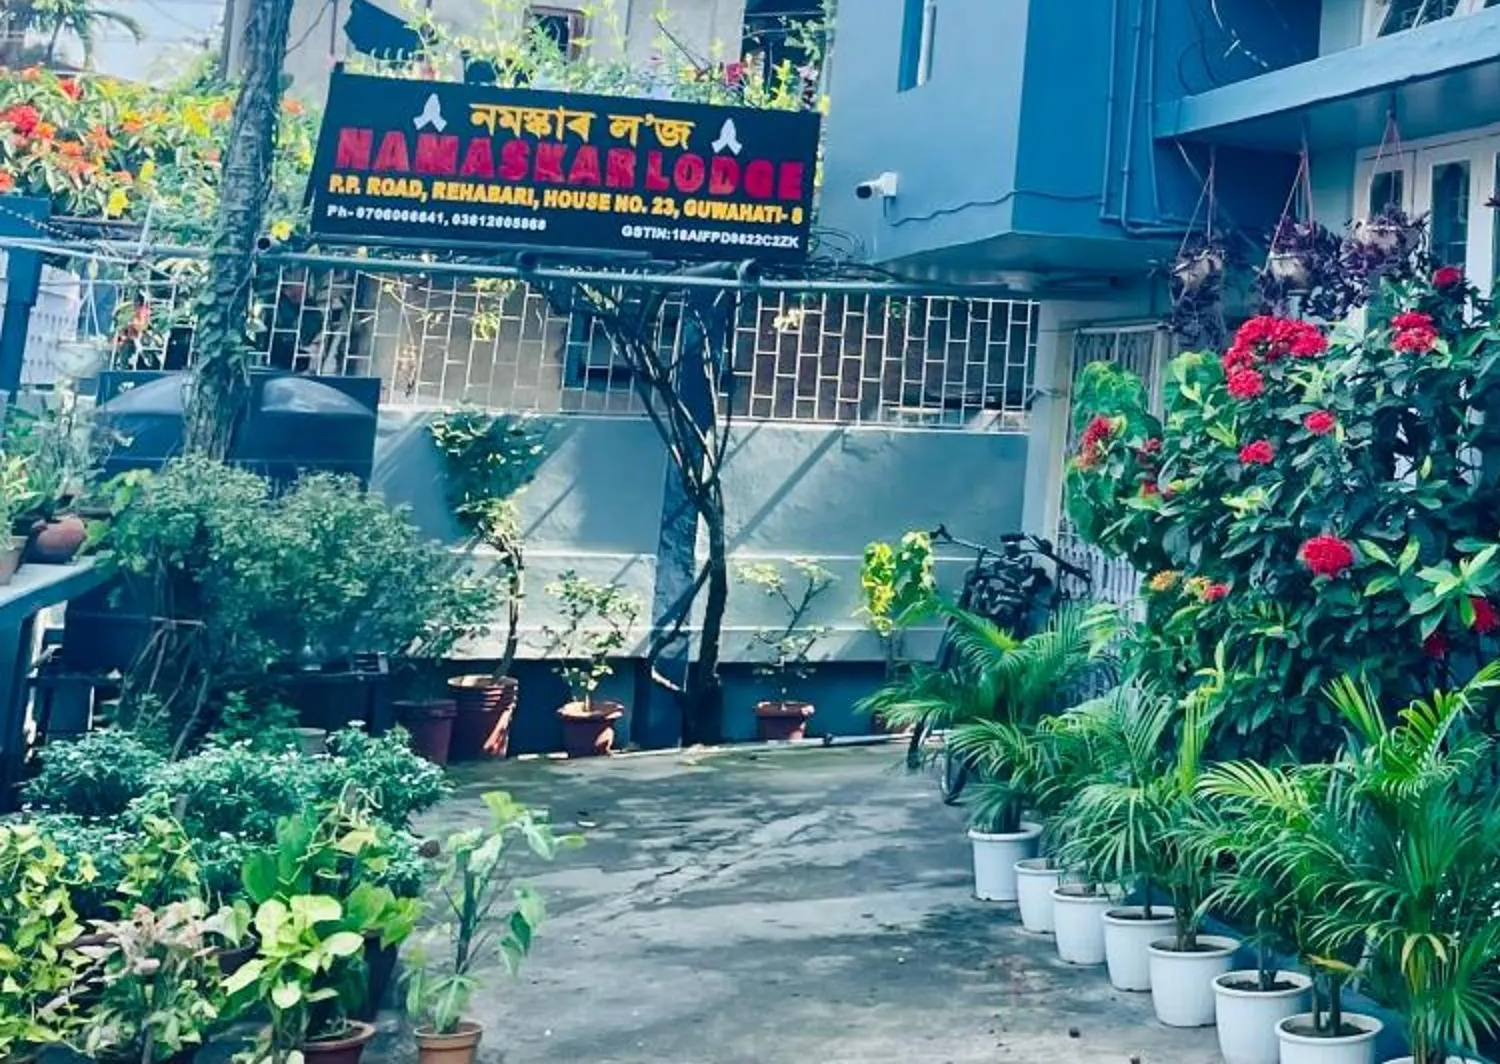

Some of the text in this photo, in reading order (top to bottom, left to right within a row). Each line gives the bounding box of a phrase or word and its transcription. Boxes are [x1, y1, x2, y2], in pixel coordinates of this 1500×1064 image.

[336, 128, 805, 200] NAMASKAR LODGE
[367, 176, 427, 201] ROAD,
[432, 181, 540, 209] REHABARI,
[543, 190, 611, 211] HOUSE
[614, 194, 647, 214] NO.
[651, 197, 679, 218] 23,
